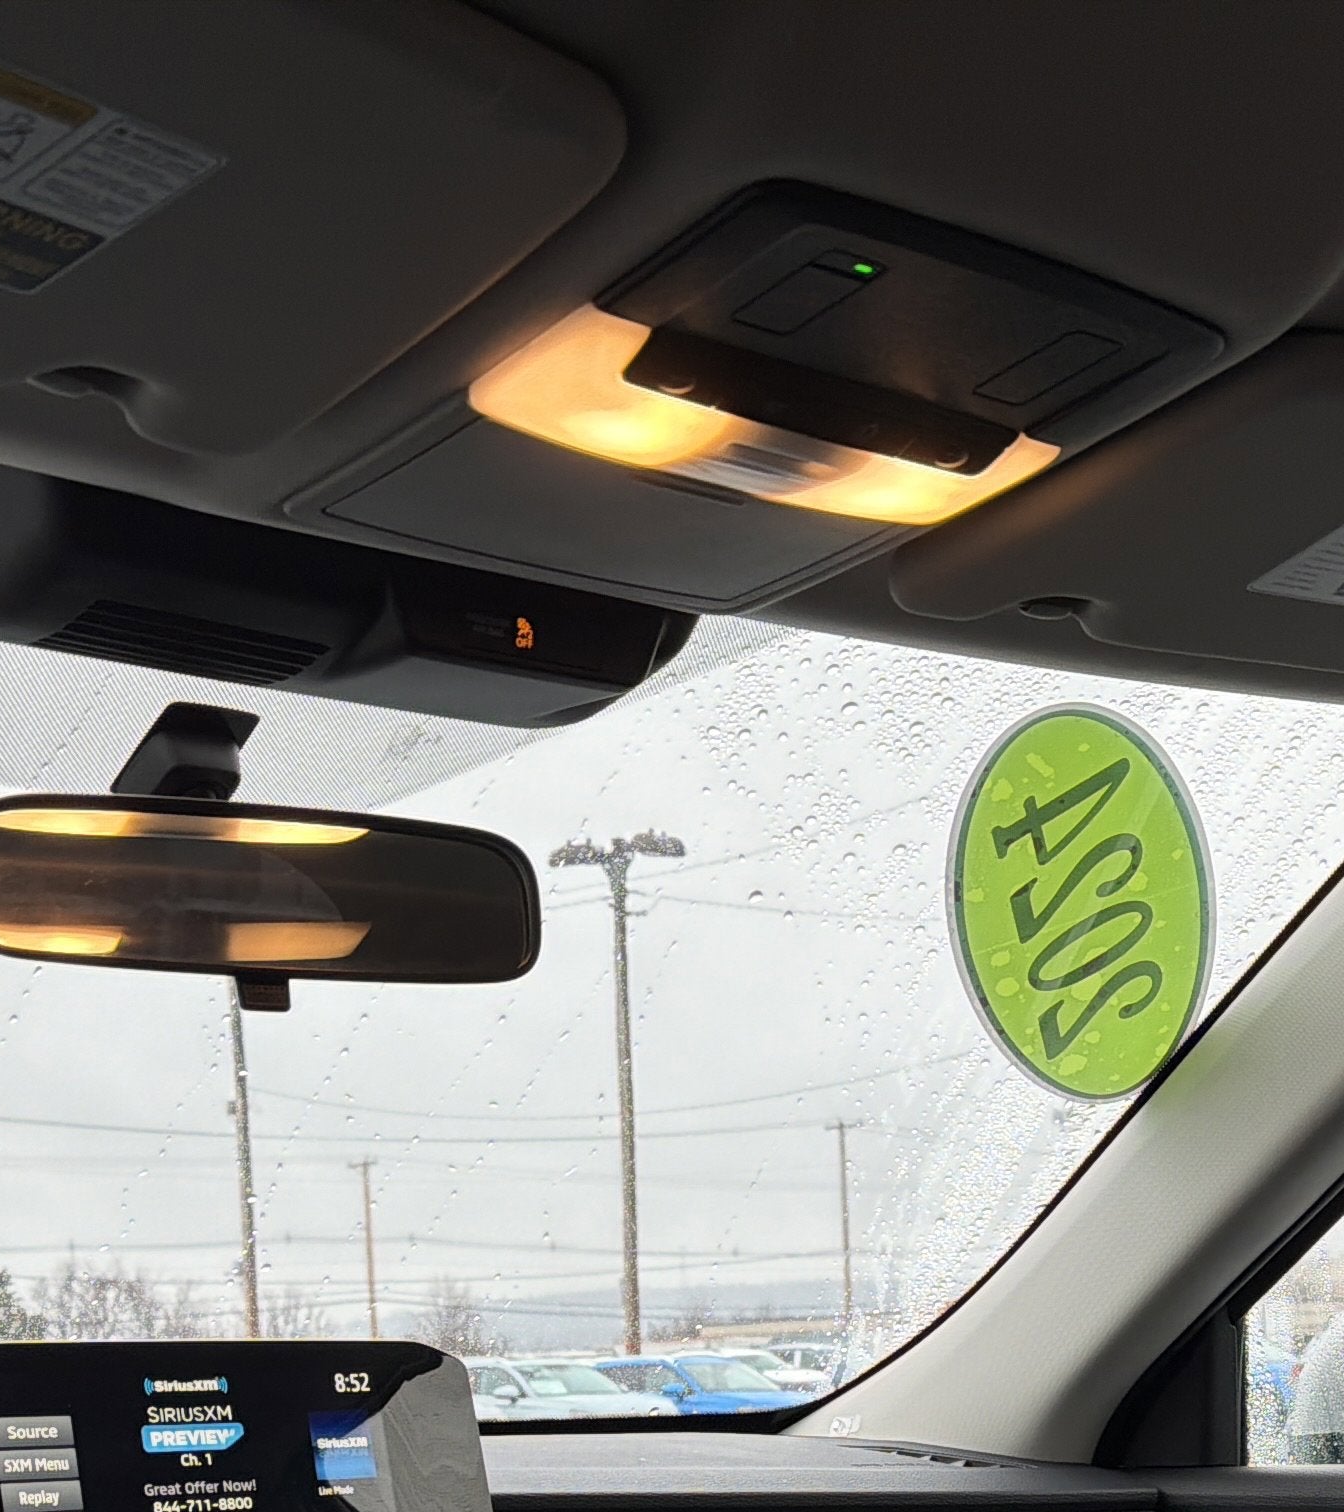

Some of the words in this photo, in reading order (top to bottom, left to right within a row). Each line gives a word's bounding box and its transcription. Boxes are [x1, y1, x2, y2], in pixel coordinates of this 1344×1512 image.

[334, 1373, 371, 1393] 8:52
[147, 1405, 233, 1423] SIRIUSXM
[7, 1426, 58, 1439] Source
[150, 1428, 236, 1446] PREVIEW
[317, 1437, 368, 1449] SiriusXM
[4, 1459, 33, 1473] SXM
[35, 1457, 70, 1472] Menu
[180, 1453, 202, 1467] Ch.
[205, 1453, 213, 1466] 1
[144, 1482, 182, 1497] Great
[185, 1480, 219, 1494] Offer
[223, 1478, 257, 1492] Now!
[18, 1490, 60, 1507] Replay
